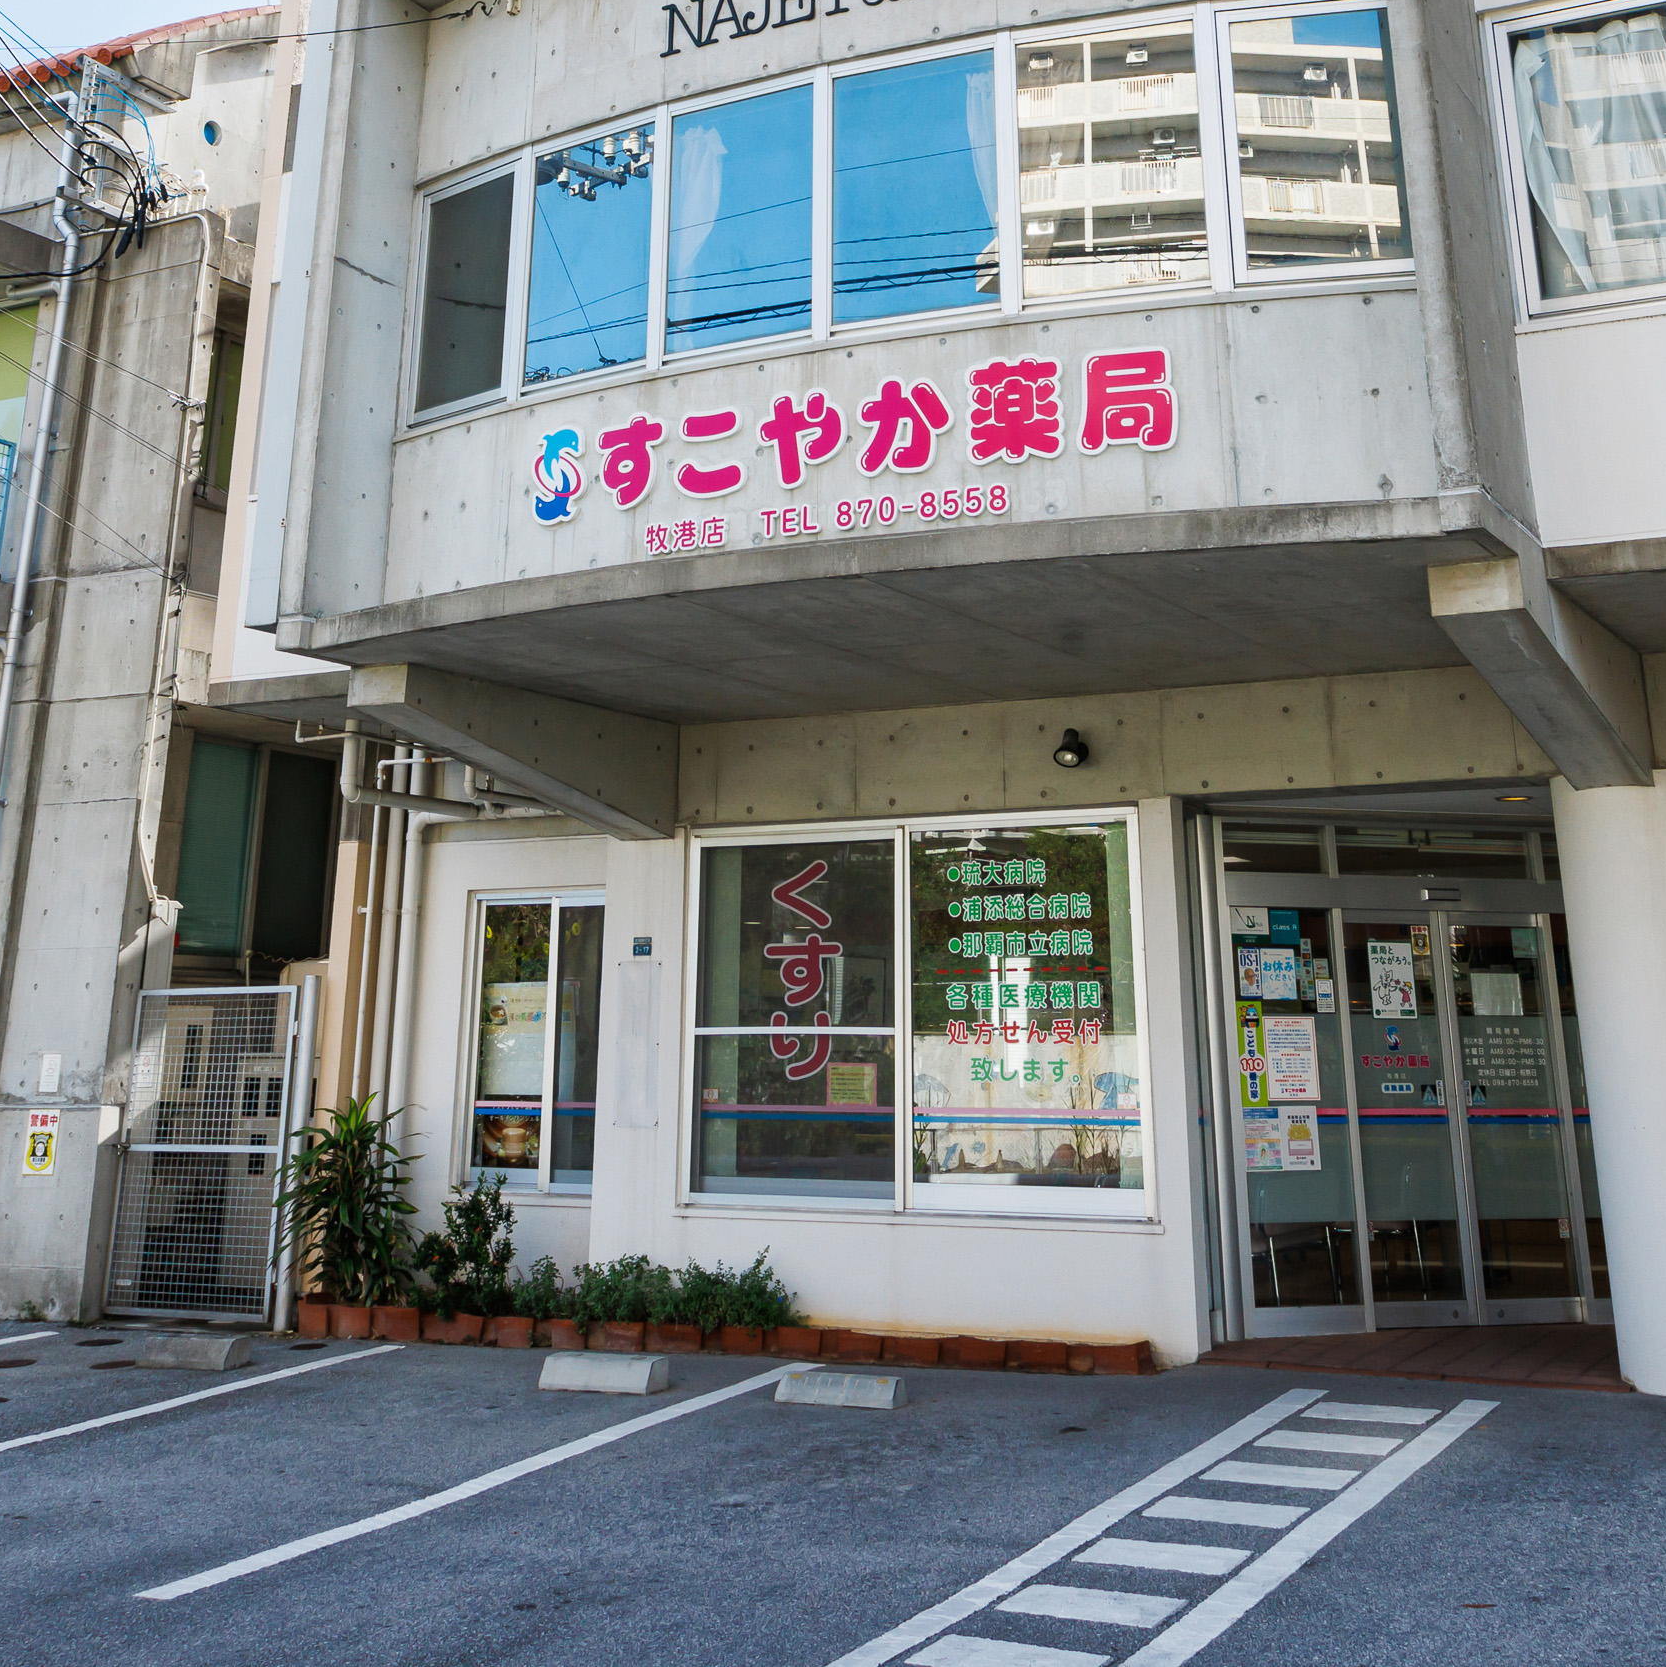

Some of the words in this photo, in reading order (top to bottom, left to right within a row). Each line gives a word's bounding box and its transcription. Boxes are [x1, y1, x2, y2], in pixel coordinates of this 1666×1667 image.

[597, 350, 1178, 510] すこやか薬局
[644, 515, 727, 555] 牧港店
[760, 506, 821, 539] TEL
[835, 483, 1012, 529] 870-8558
[961, 858, 1047, 886] 琉大病院
[962, 891, 1092, 922] 浦添総合病院
[962, 929, 1094, 958] 那覇市立病院
[1370, 945, 1394, 955] 薬局と
[763, 859, 843, 1081] くすり
[1239, 954, 1259, 967] OS-1
[1262, 960, 1294, 973] お休み
[1371, 955, 1411, 966] つながろう。
[1269, 973, 1295, 982] ください
[945, 981, 1101, 1010] 各種医療機関
[946, 1019, 1103, 1046] 処方せん受付
[970, 1057, 1081, 1084] 致します。
[1360, 1054, 1430, 1068] すこやか薬局
[30, 1114, 59, 1128] 警備中
